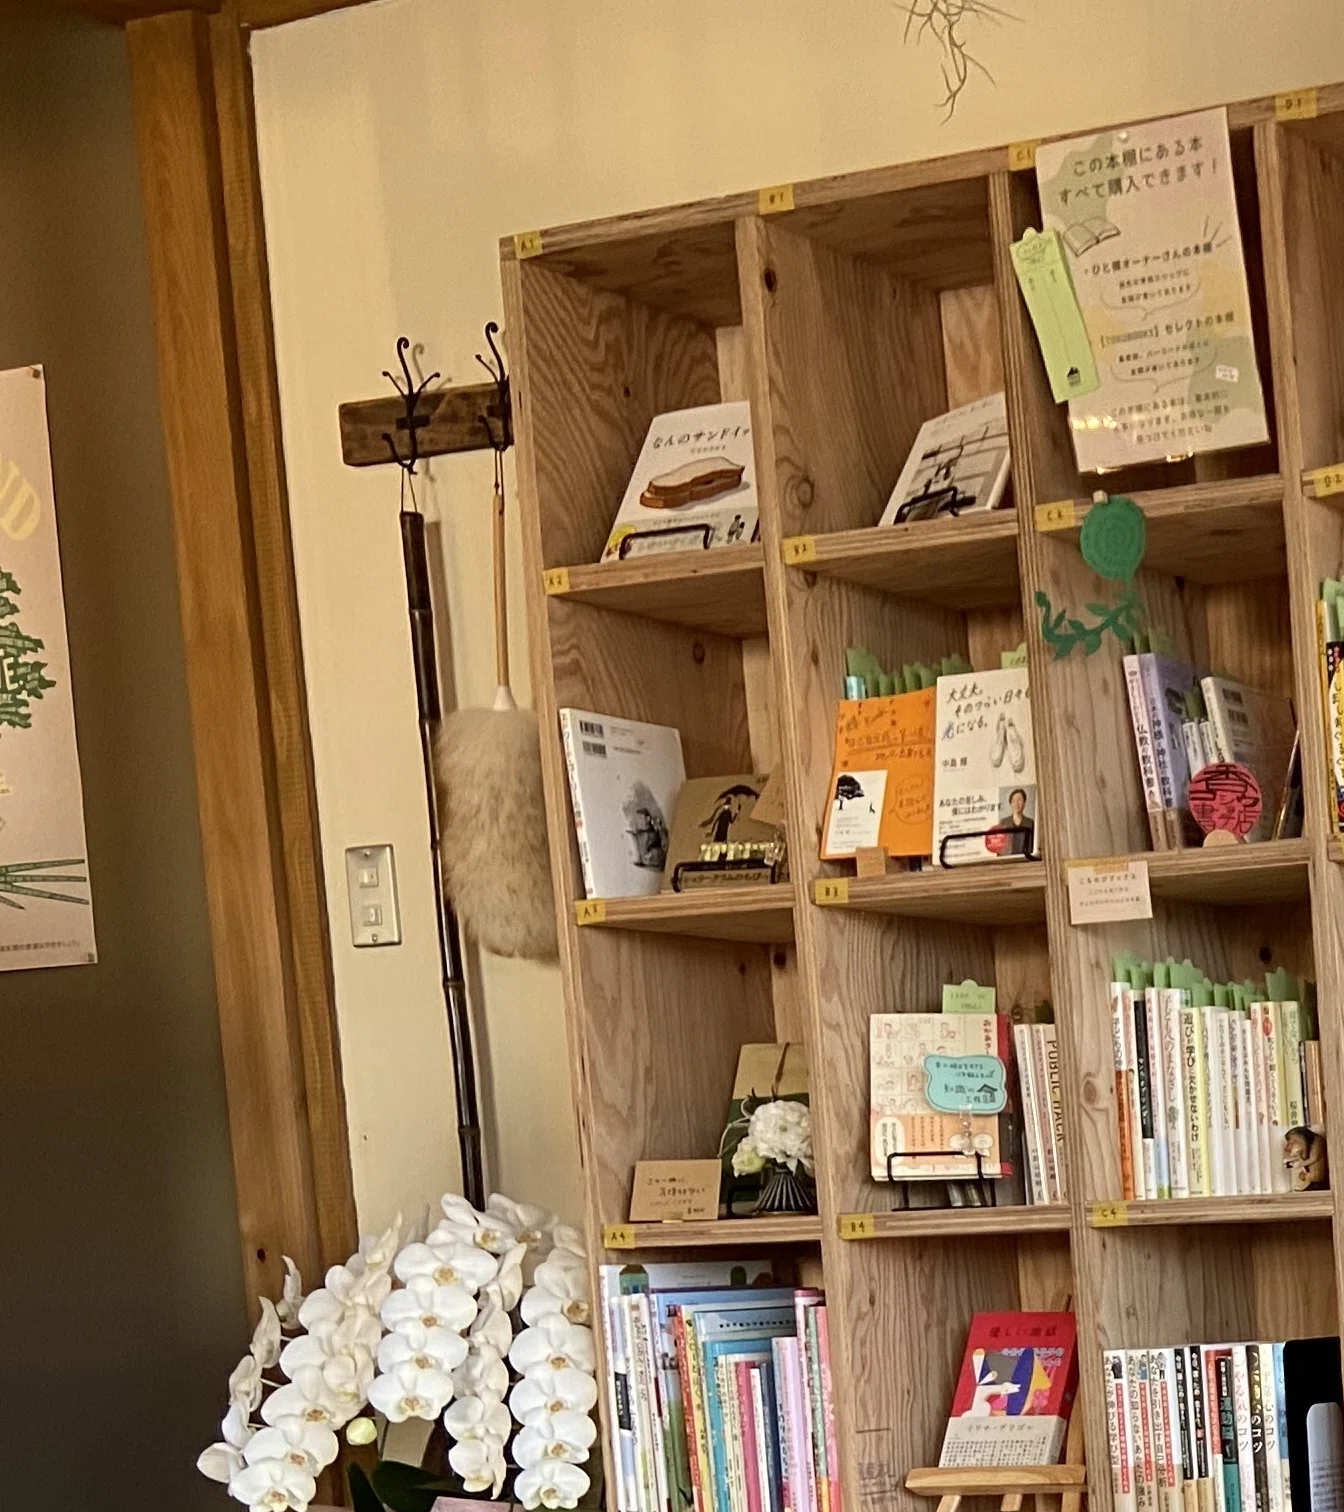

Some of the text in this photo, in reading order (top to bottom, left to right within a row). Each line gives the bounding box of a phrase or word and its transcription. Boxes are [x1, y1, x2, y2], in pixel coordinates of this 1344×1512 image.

[1073, 135, 1205, 177] この本棚にある本
[1058, 160, 1219, 206] すべて購入できます！
[1046, 1039, 1061, 1097] PUBLIC
